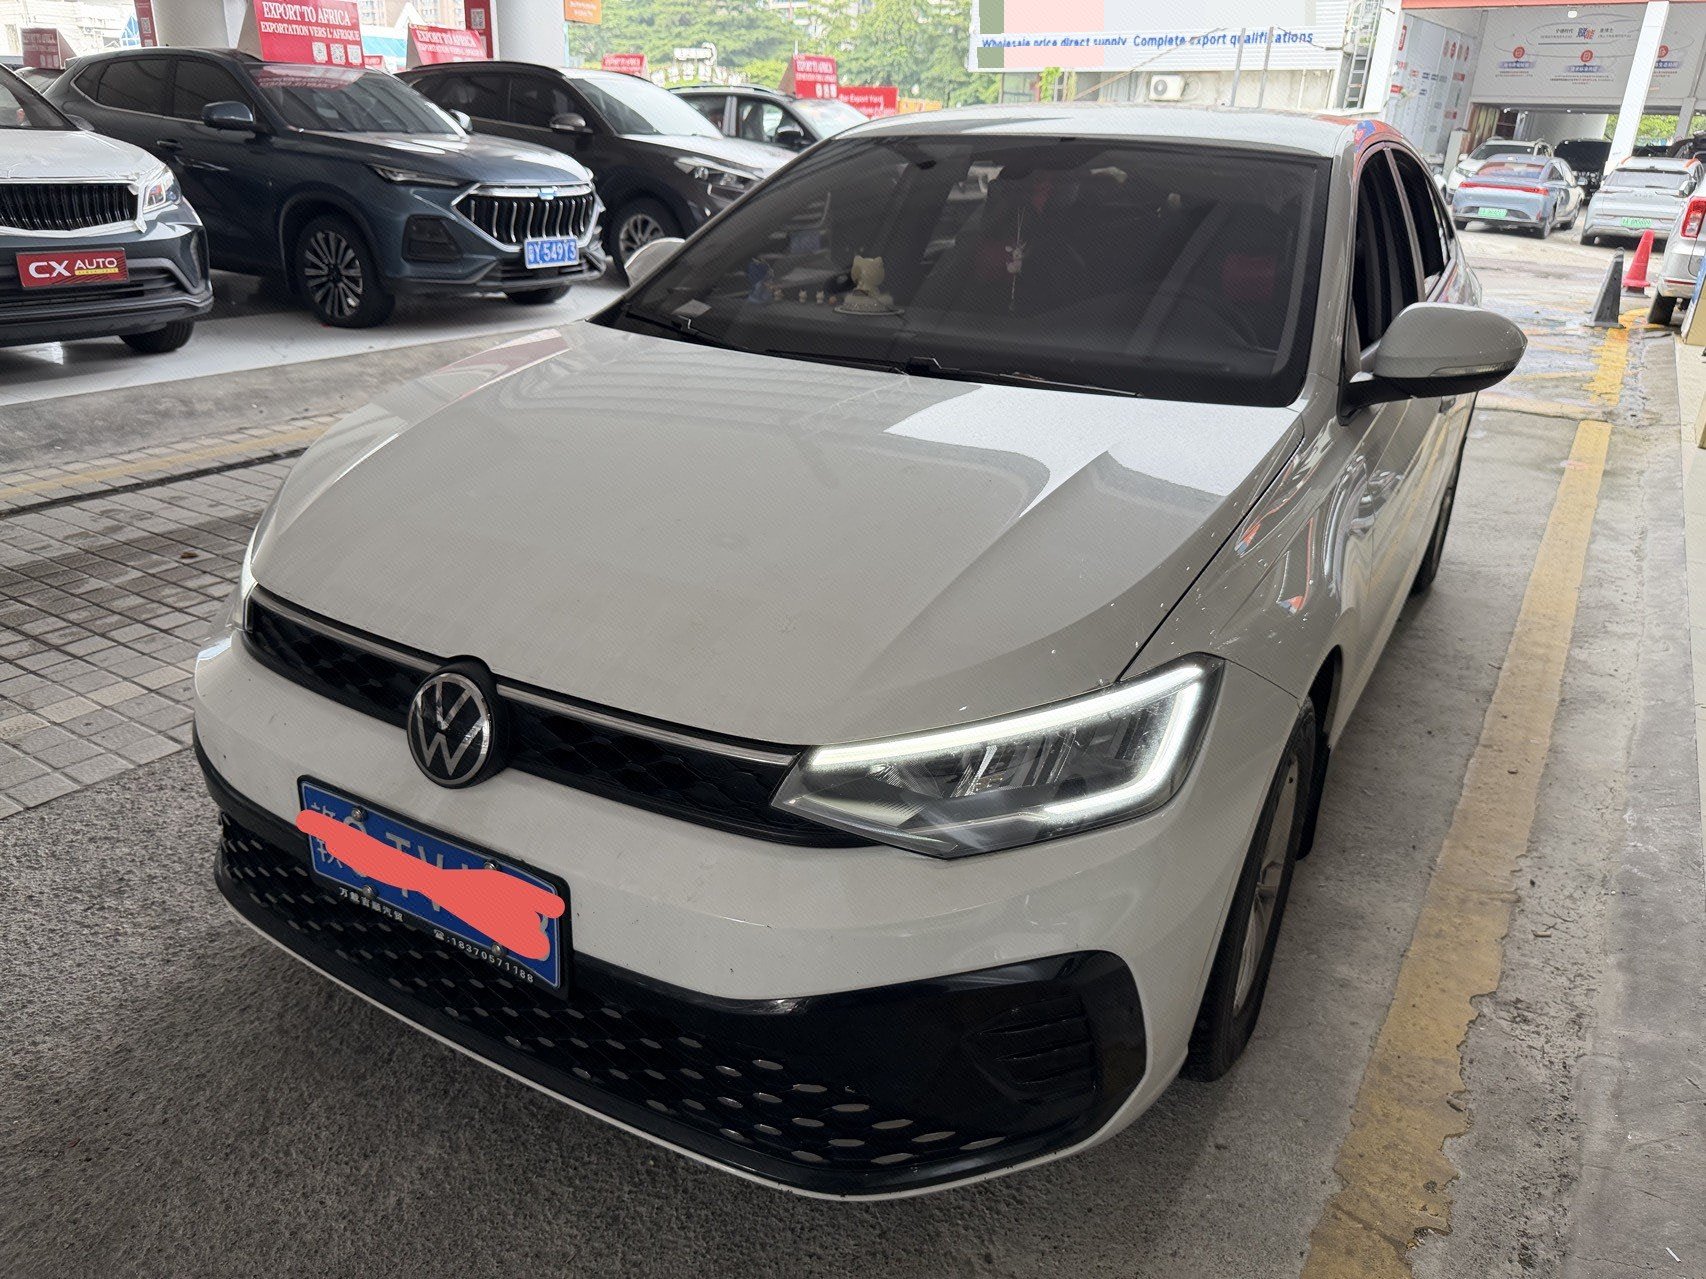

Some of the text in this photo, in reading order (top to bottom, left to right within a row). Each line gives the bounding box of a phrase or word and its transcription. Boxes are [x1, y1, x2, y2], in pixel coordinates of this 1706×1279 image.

[262, 2, 352, 26] EXPORT TO AFRICA
[260, 21, 361, 41] EXPORTATION VERS L'AFRIQUE
[1060, 37, 1090, 47] direct
[1133, 35, 1186, 49] Complete
[1230, 32, 1313, 48] qalifiations
[28, 260, 72, 279] CX
[74, 257, 118, 270] AUTO
